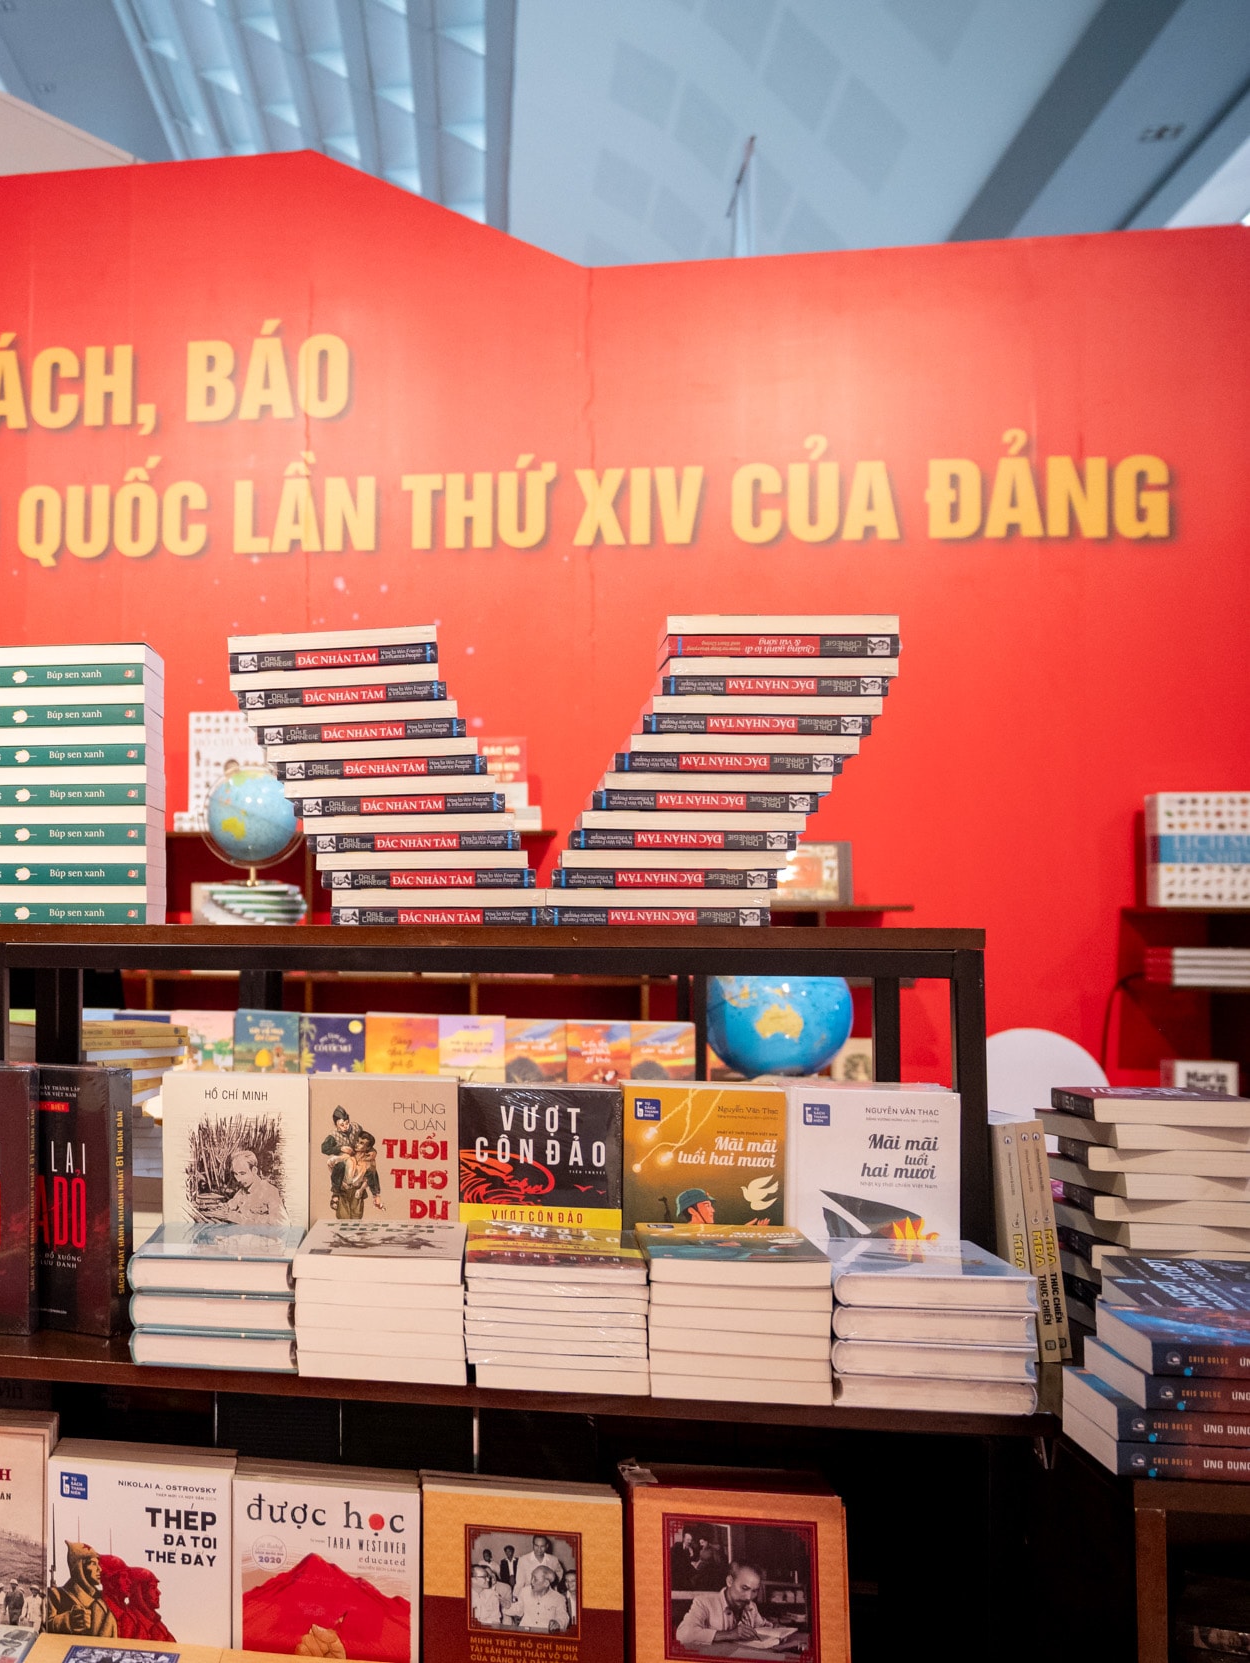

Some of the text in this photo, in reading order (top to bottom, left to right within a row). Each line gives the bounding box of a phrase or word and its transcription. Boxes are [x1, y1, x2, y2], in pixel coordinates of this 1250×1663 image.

[186, 320, 350, 423] BÁO
[16, 456, 207, 567] QUỐC
[233, 451, 377, 553] LẦN
[401, 454, 556, 550] THỨ
[573, 466, 703, 546] XIV
[730, 435, 899, 543] CỦA
[926, 429, 1171, 539] ĐẢNG
[47, 670, 63, 681] Búp
[82, 670, 102, 678] xanh
[204, 1089, 268, 1101] HỒ CHÍ MINH
[392, 1101, 446, 1115] PHÙNG
[866, 1106, 898, 1115] NGUYỄN
[900, 1107, 916, 1115] VĂN
[403, 1118, 446, 1131] QUÁN
[500, 1103, 581, 1136] VƯỢT
[382, 1132, 449, 1161] TUỔI
[475, 1134, 606, 1167] CÔN ĐẢO
[715, 1136, 777, 1153] Mãi mãi
[868, 1134, 939, 1152] Mãi mãi
[115, 1155, 124, 1167] 81
[678, 1147, 776, 1168] tuổi hai mươi
[904, 1153, 928, 1166] tuổi
[390, 1169, 449, 1190] THƠ
[861, 1163, 936, 1179] hai mươi
[409, 1195, 452, 1220] DỮ
[1033, 1230, 1046, 1268] MBA
[118, 1480, 153, 1489] NIKOLAI
[166, 1485, 217, 1494] OSTROVSKY
[145, 1503, 217, 1532] THÉP
[246, 1493, 405, 1536] được học
[327, 1536, 406, 1555] TARA WESTOVER
[145, 1548, 217, 1567] THẾ ĐẤY
[258, 1555, 282, 1564] 2020
[358, 1555, 406, 1566] educated
[555, 1644, 578, 1652] MINH
